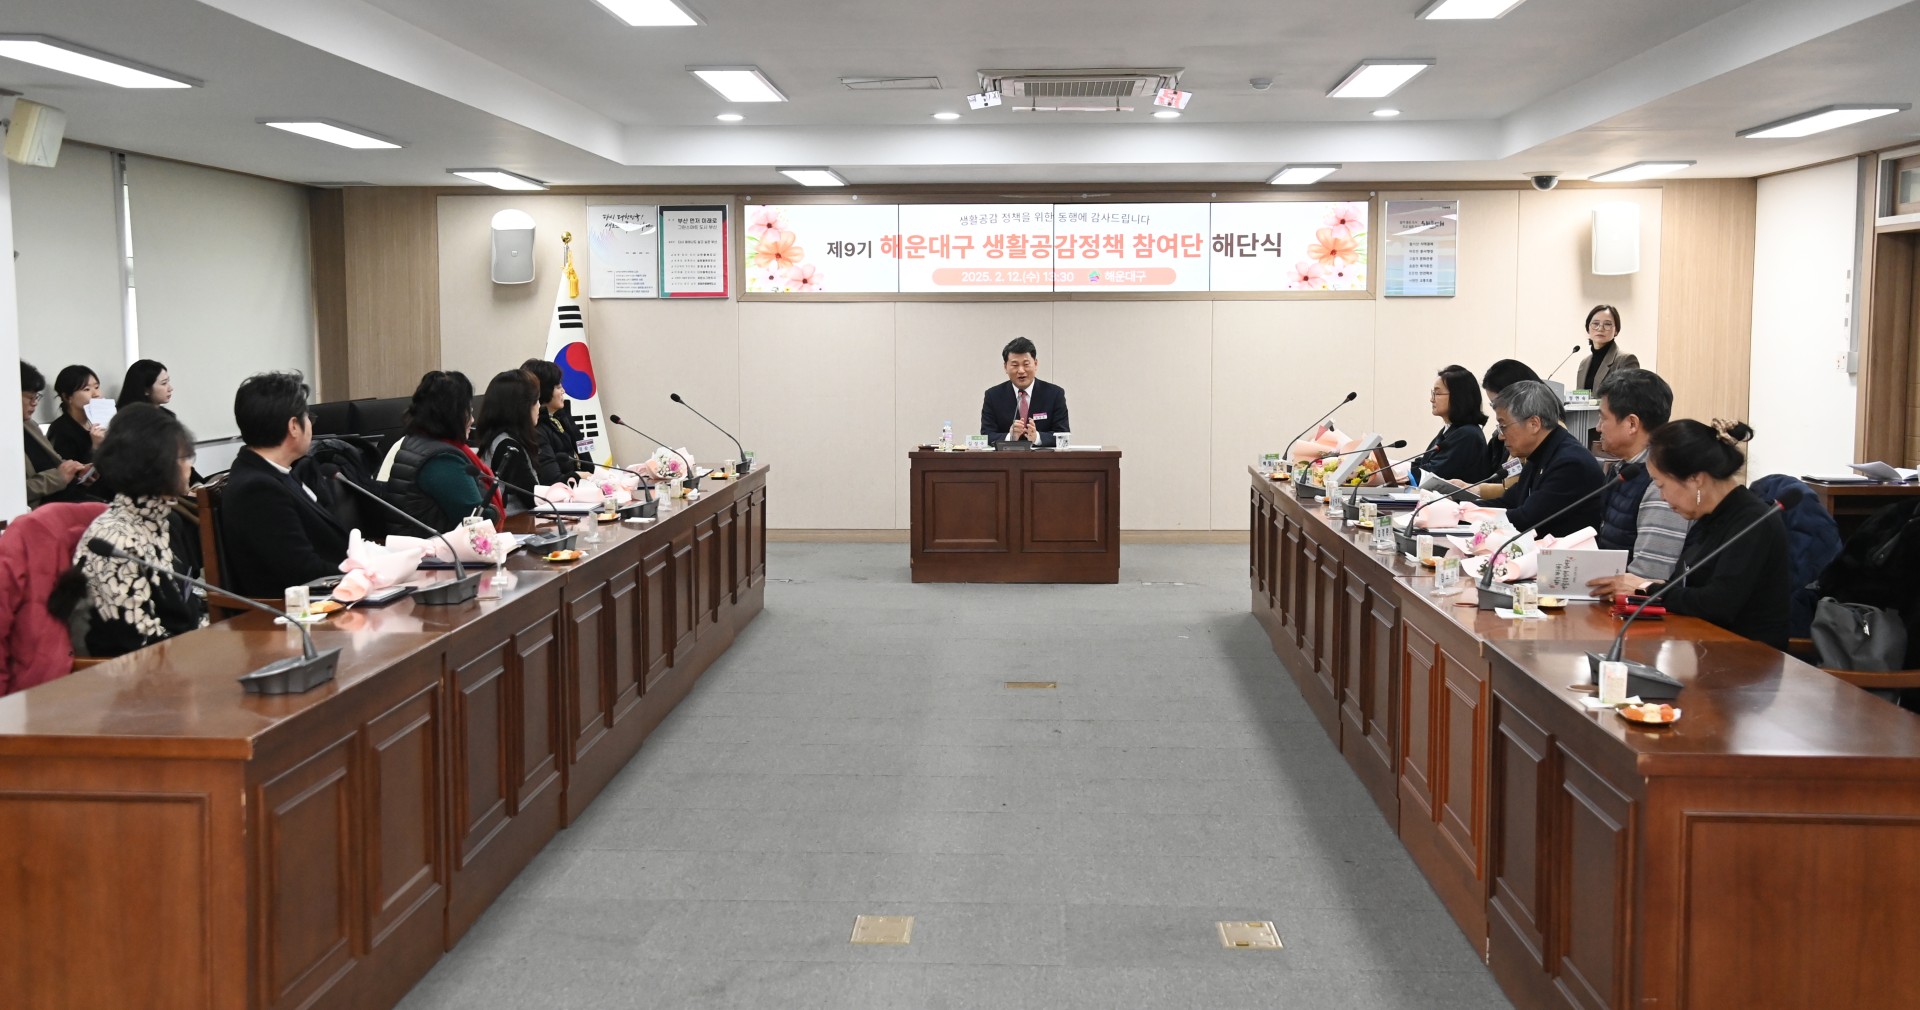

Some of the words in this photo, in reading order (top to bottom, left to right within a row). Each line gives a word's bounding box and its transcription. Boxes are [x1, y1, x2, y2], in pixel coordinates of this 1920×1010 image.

[959, 212, 998, 226] 생활공감
[1001, 211, 1031, 224] 정책을
[1034, 211, 1054, 224] 위한
[1058, 211, 1088, 224] 동행에
[1090, 211, 1150, 226] 감사드립니다
[826, 240, 873, 259] 제9기
[879, 233, 976, 260] 해운대구
[982, 232, 1125, 260] 생활공감정책
[1132, 232, 1204, 259] 참여단
[1211, 232, 1283, 259] 해단식
[961, 271, 992, 284] 2025.
[994, 271, 1004, 284] 2.
[1007, 270, 1041, 285] 12.(수)
[1104, 270, 1147, 284] 해운대구
